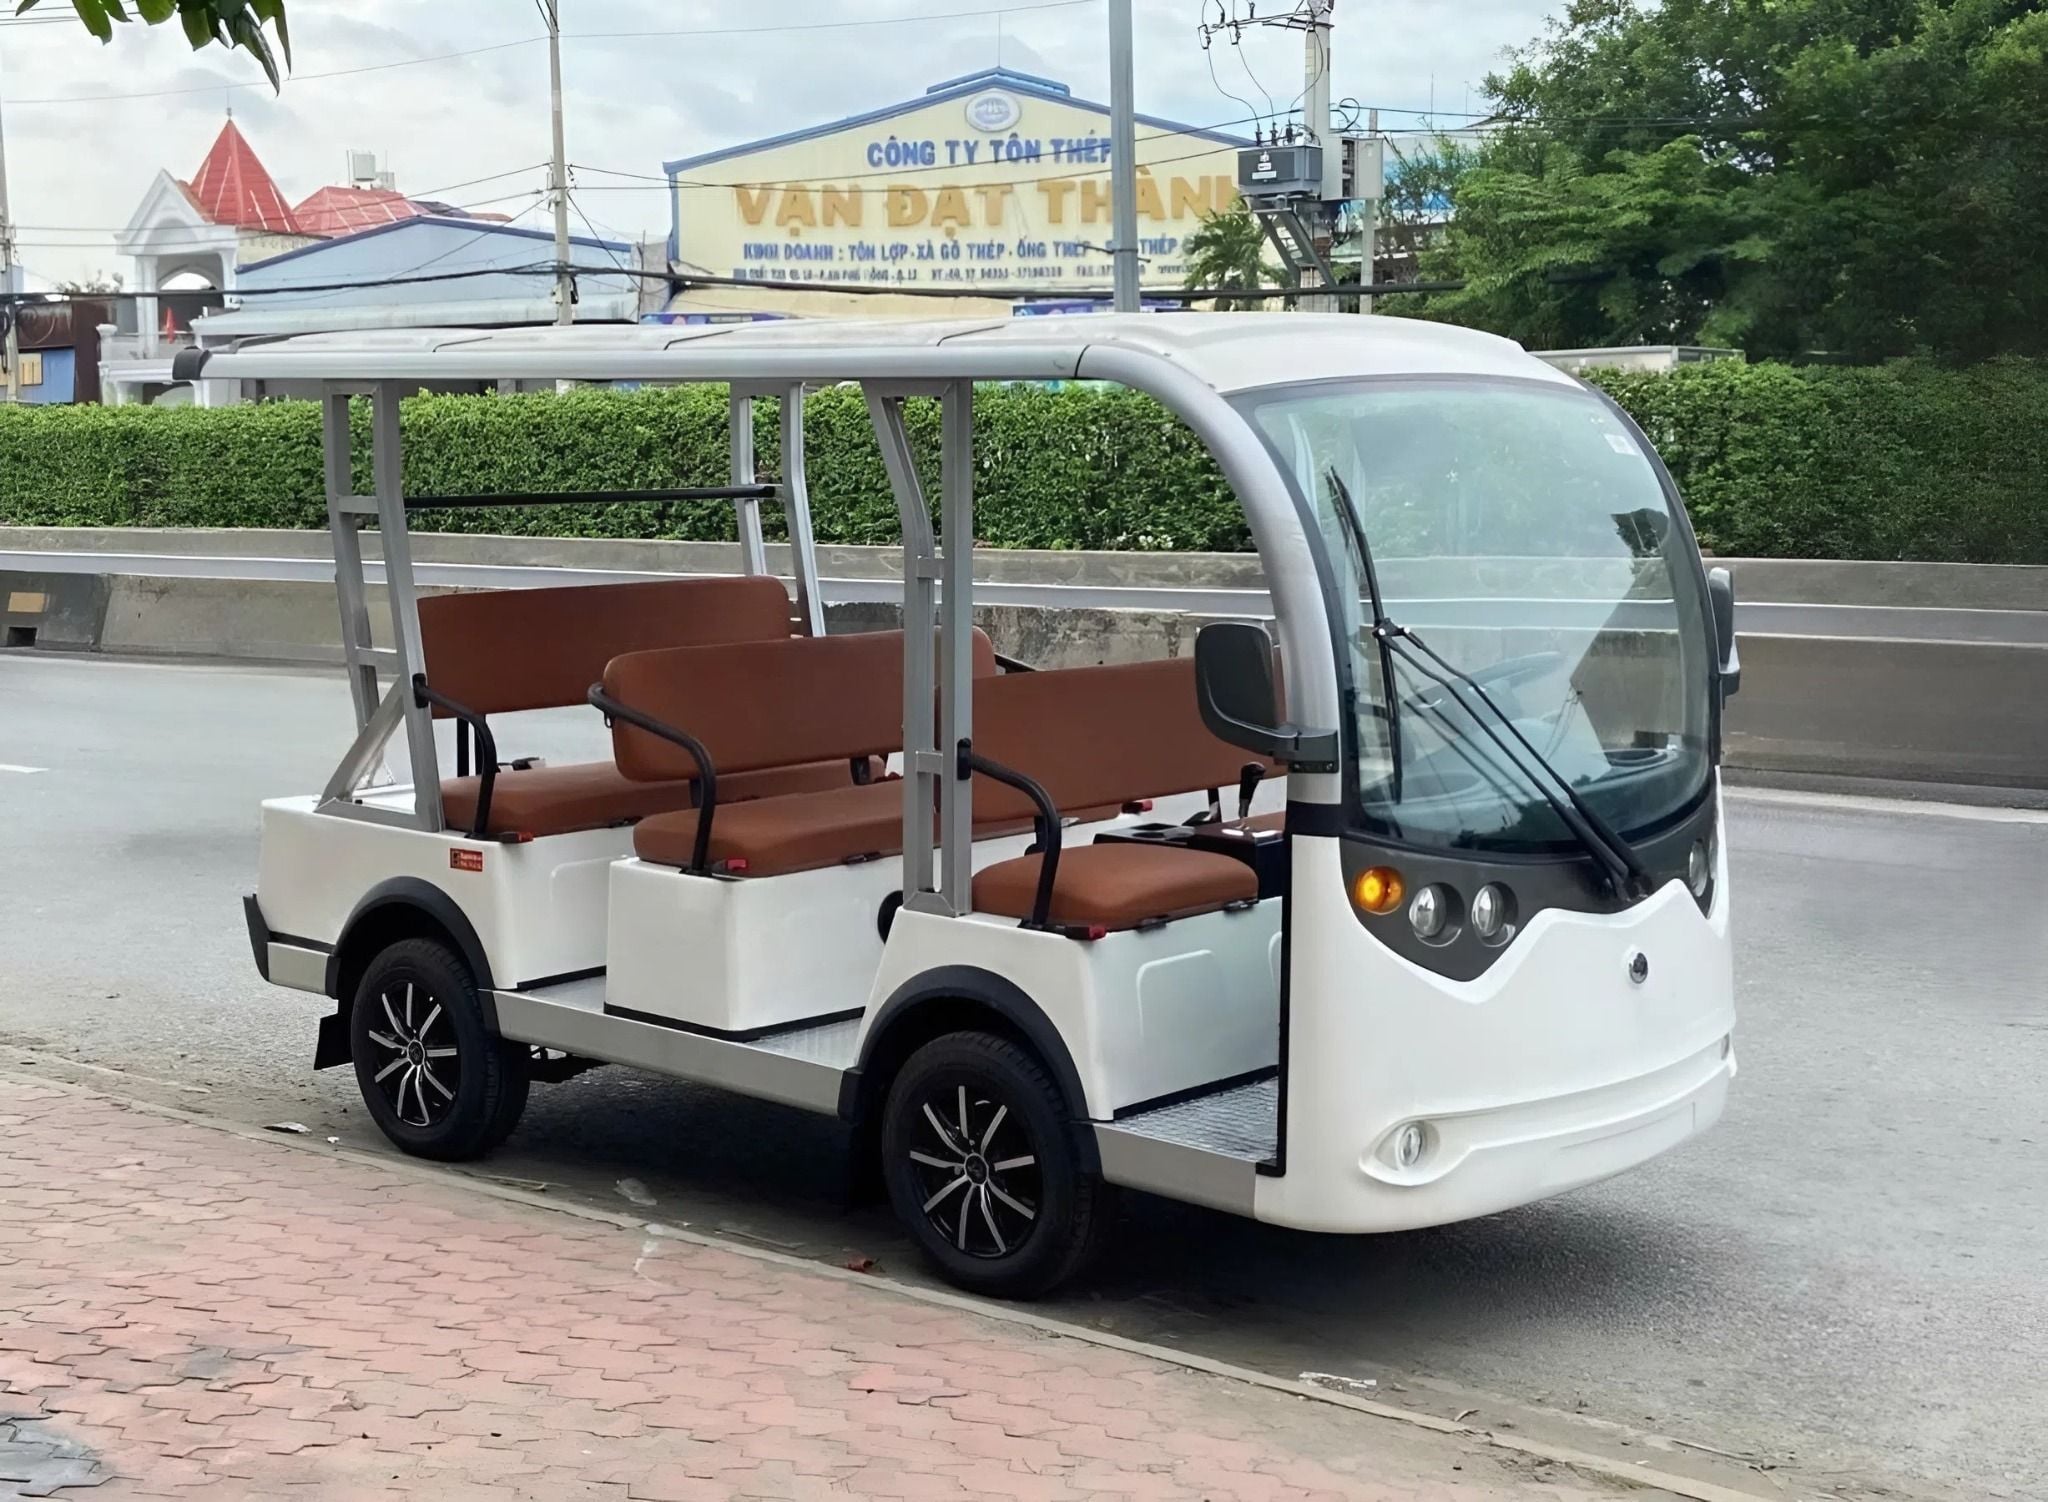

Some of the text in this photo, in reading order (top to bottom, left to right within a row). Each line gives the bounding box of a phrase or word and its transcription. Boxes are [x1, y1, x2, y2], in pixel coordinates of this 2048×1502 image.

[867, 135, 935, 167] CÔNG
[945, 139, 979, 165] TY
[989, 132, 1041, 163] TÔN
[733, 183, 863, 237] VẠN
[884, 182, 1013, 238] ĐẠT
